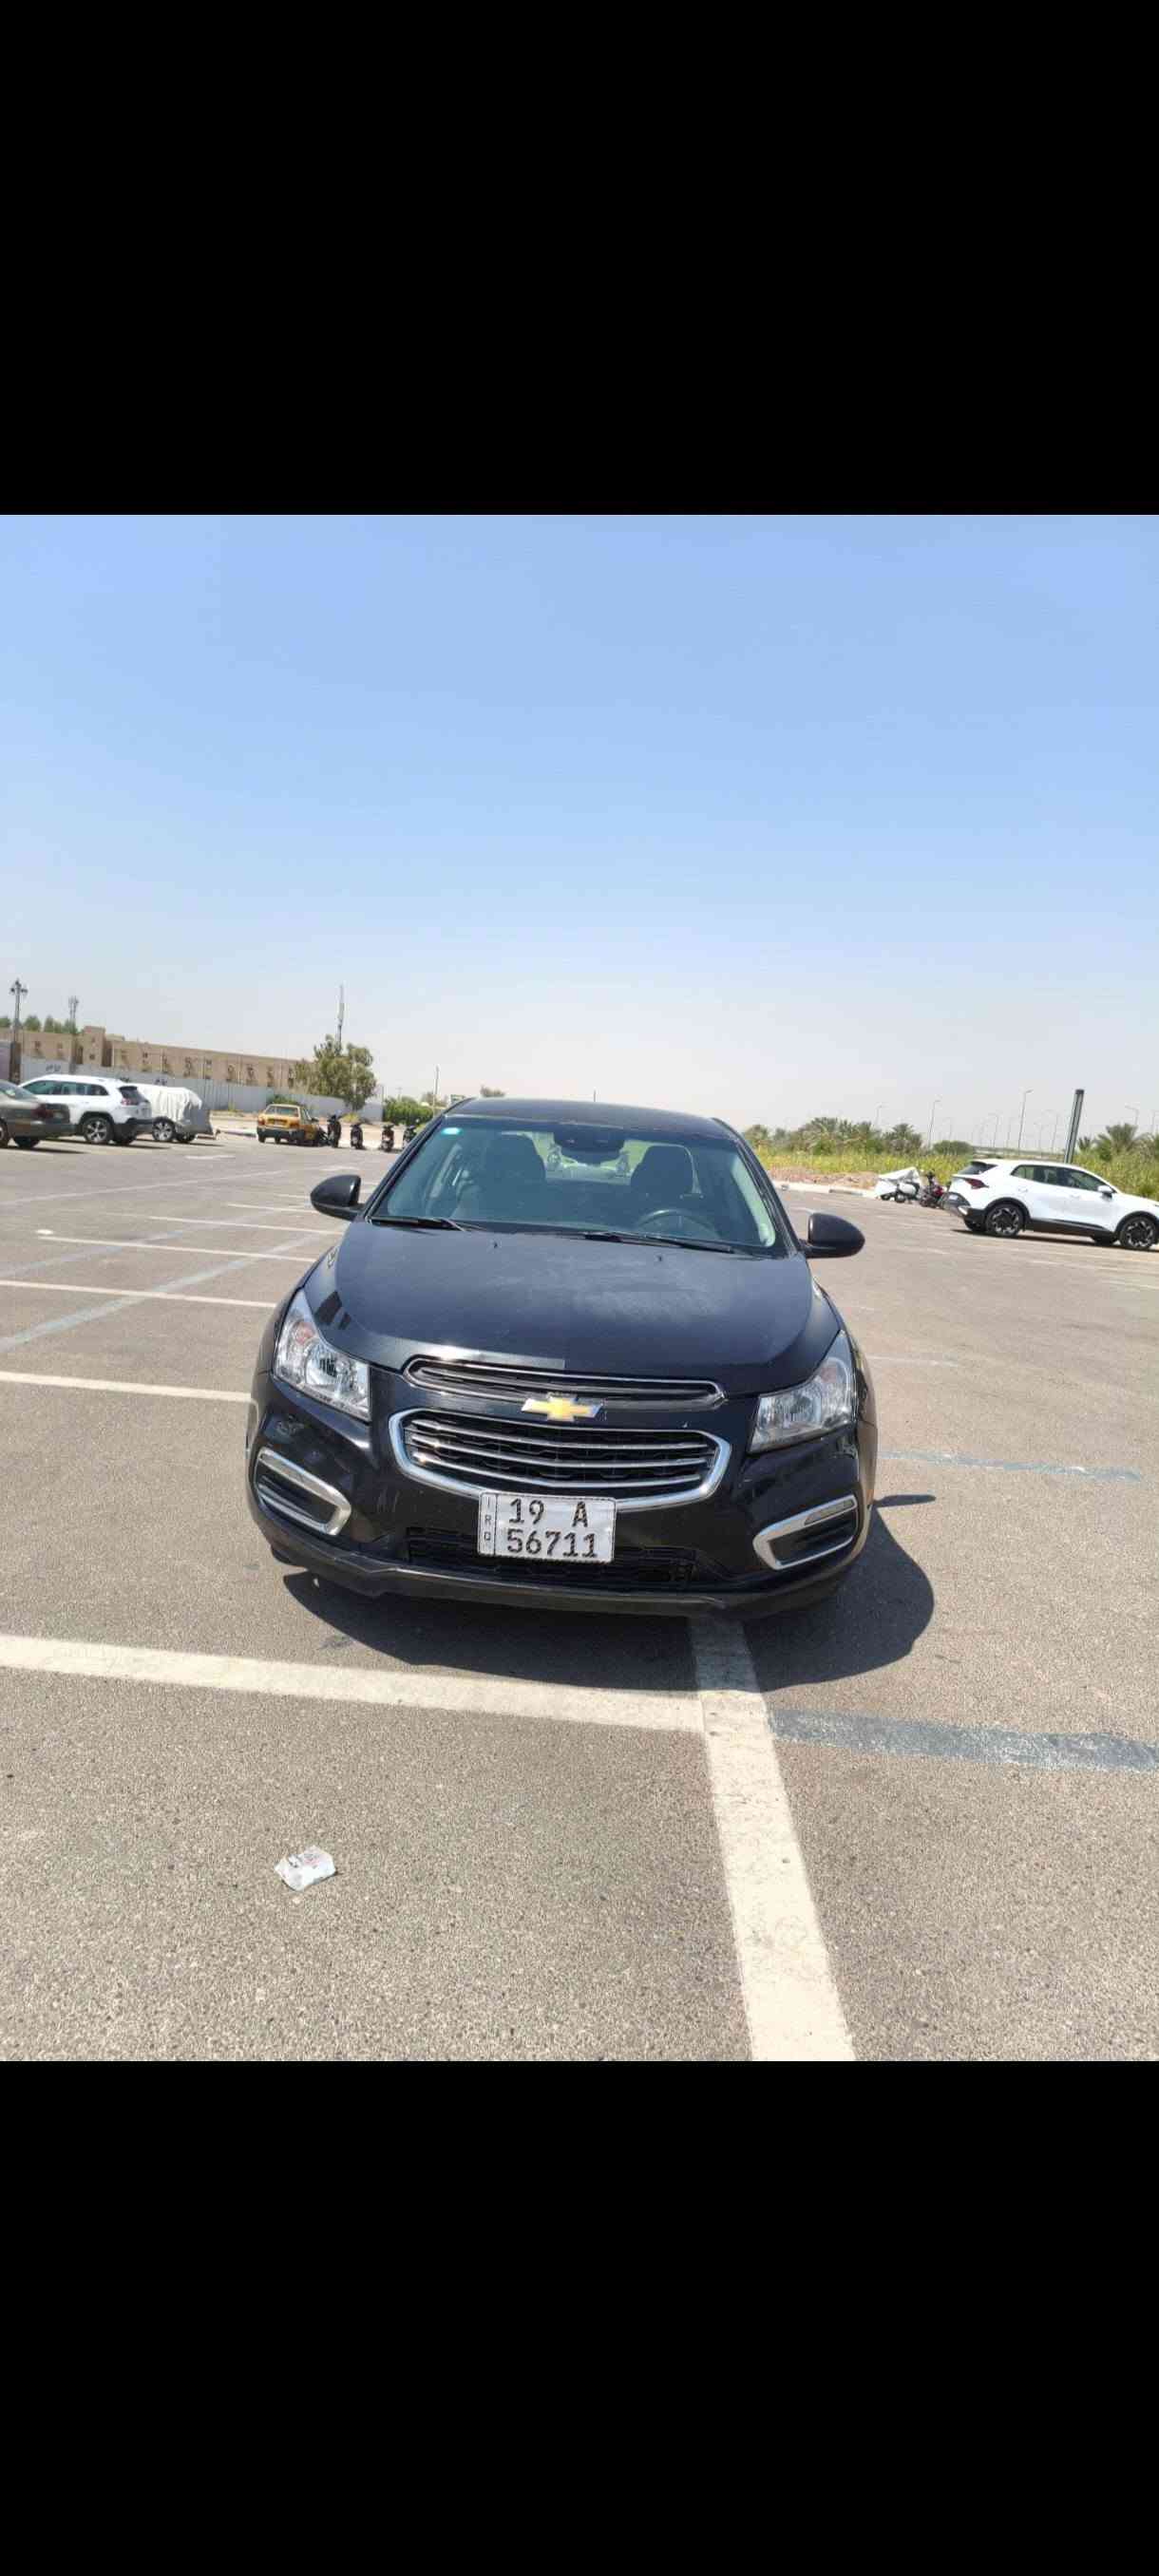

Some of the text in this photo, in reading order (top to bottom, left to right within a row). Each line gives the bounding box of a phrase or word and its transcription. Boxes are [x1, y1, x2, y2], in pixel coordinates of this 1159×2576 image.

[509, 1498, 588, 1527] 19 A
[507, 1528, 597, 1558] 56711
